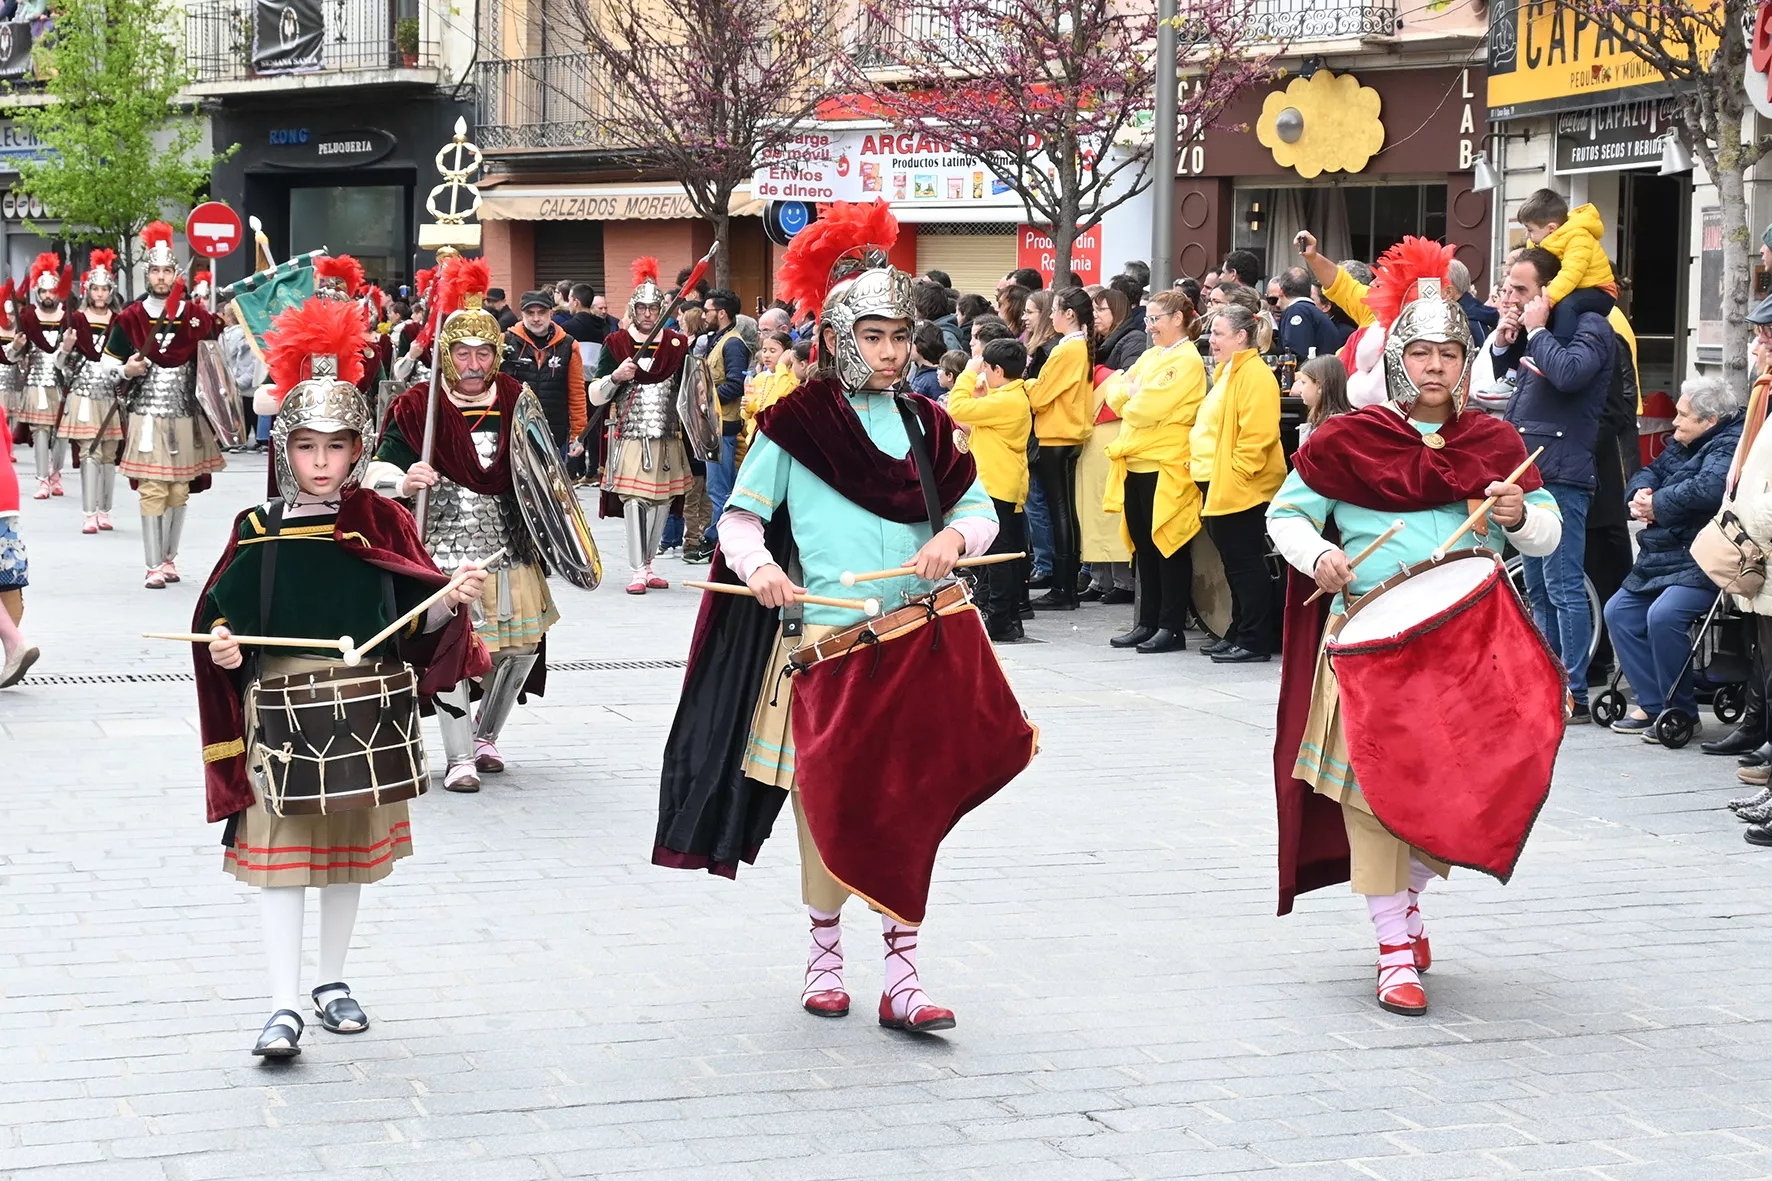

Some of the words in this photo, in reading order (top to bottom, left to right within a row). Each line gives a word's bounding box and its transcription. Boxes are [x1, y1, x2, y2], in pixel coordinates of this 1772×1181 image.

[1614, 64, 1621, 81] Y
[1176, 113, 1205, 141] PA
[1459, 69, 1475, 169] LAB
[269, 128, 310, 145] RONG
[318, 141, 372, 155] PELUQUERIA
[1571, 145, 1600, 163] FRUTOS
[1601, 141, 1626, 160] SECOS
[1627, 141, 1633, 157] Y
[892, 155, 939, 169] Productos
[1176, 145, 1205, 174] ZO
[759, 183, 778, 195] de
[782, 183, 833, 198] dinero
[539, 197, 618, 217] CALZADOS
[623, 196, 693, 216] MORENO
